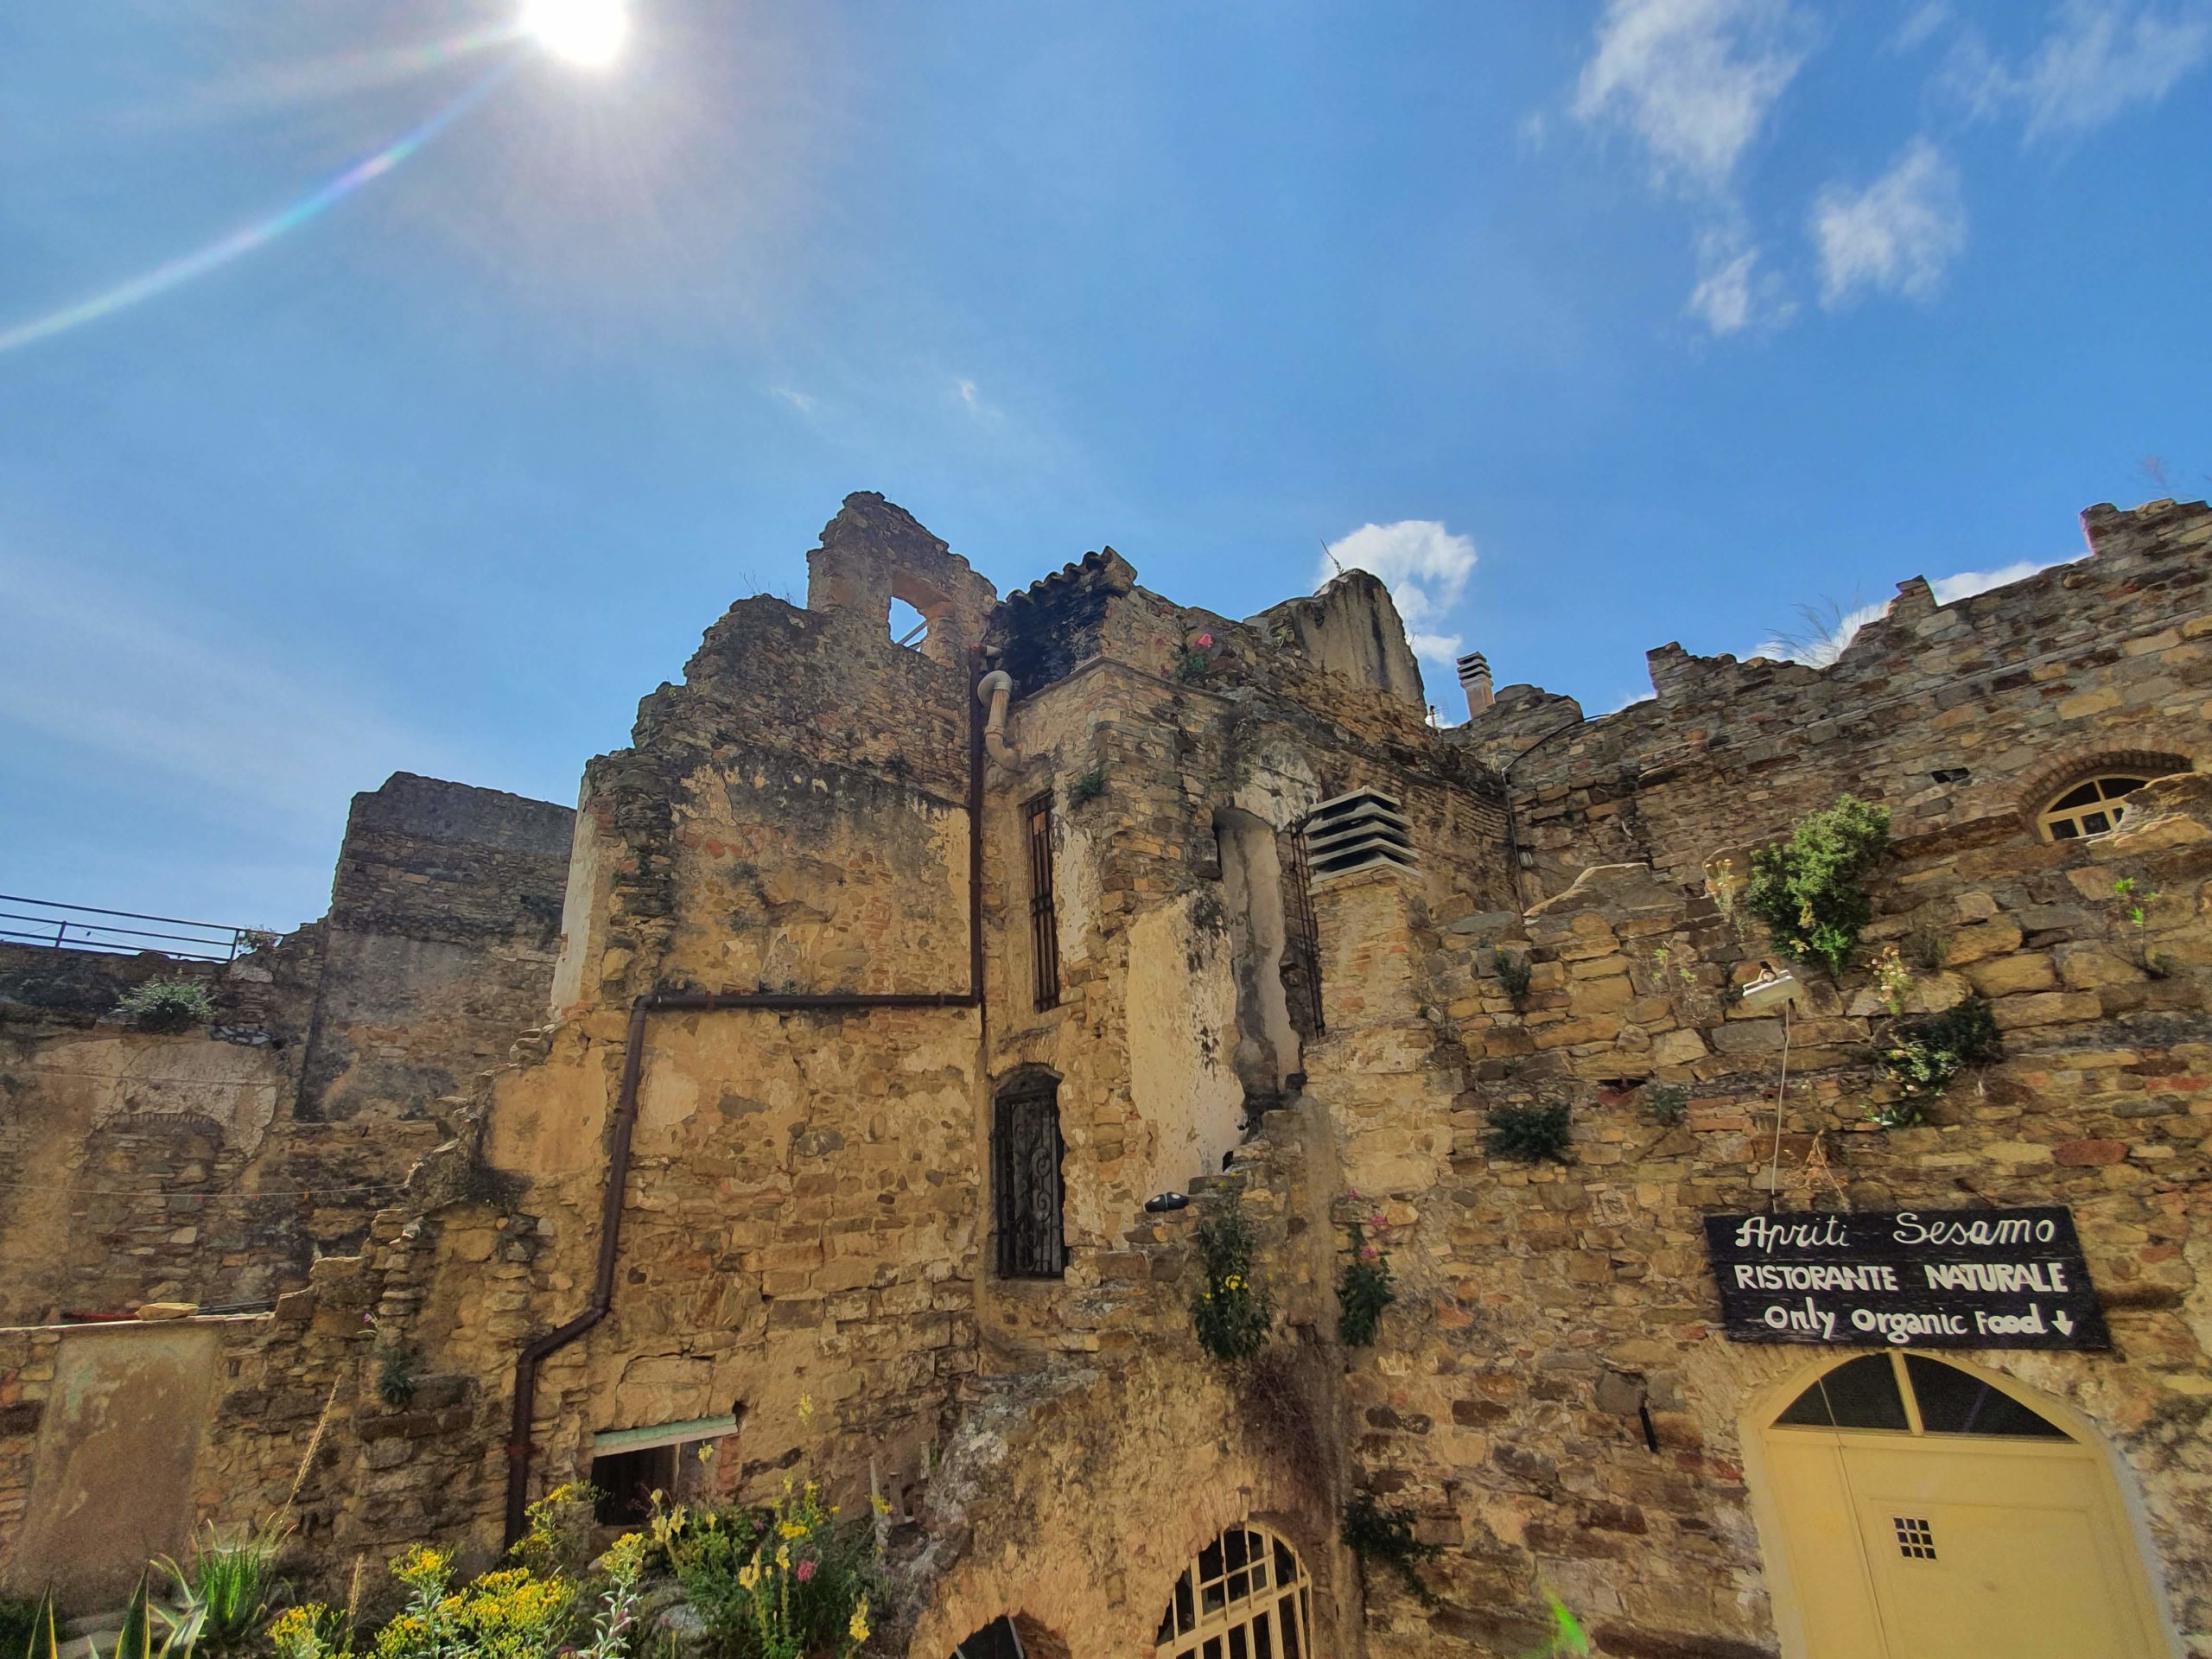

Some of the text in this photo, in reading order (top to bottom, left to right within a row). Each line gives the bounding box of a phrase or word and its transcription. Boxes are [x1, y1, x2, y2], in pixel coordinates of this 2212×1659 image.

[1735, 1212, 2055, 1253] Apriti Sesamo
[1734, 1263, 2069, 1293] RISTORANTE NATURALE
[1764, 1297, 2048, 1344] Only Organic Food
